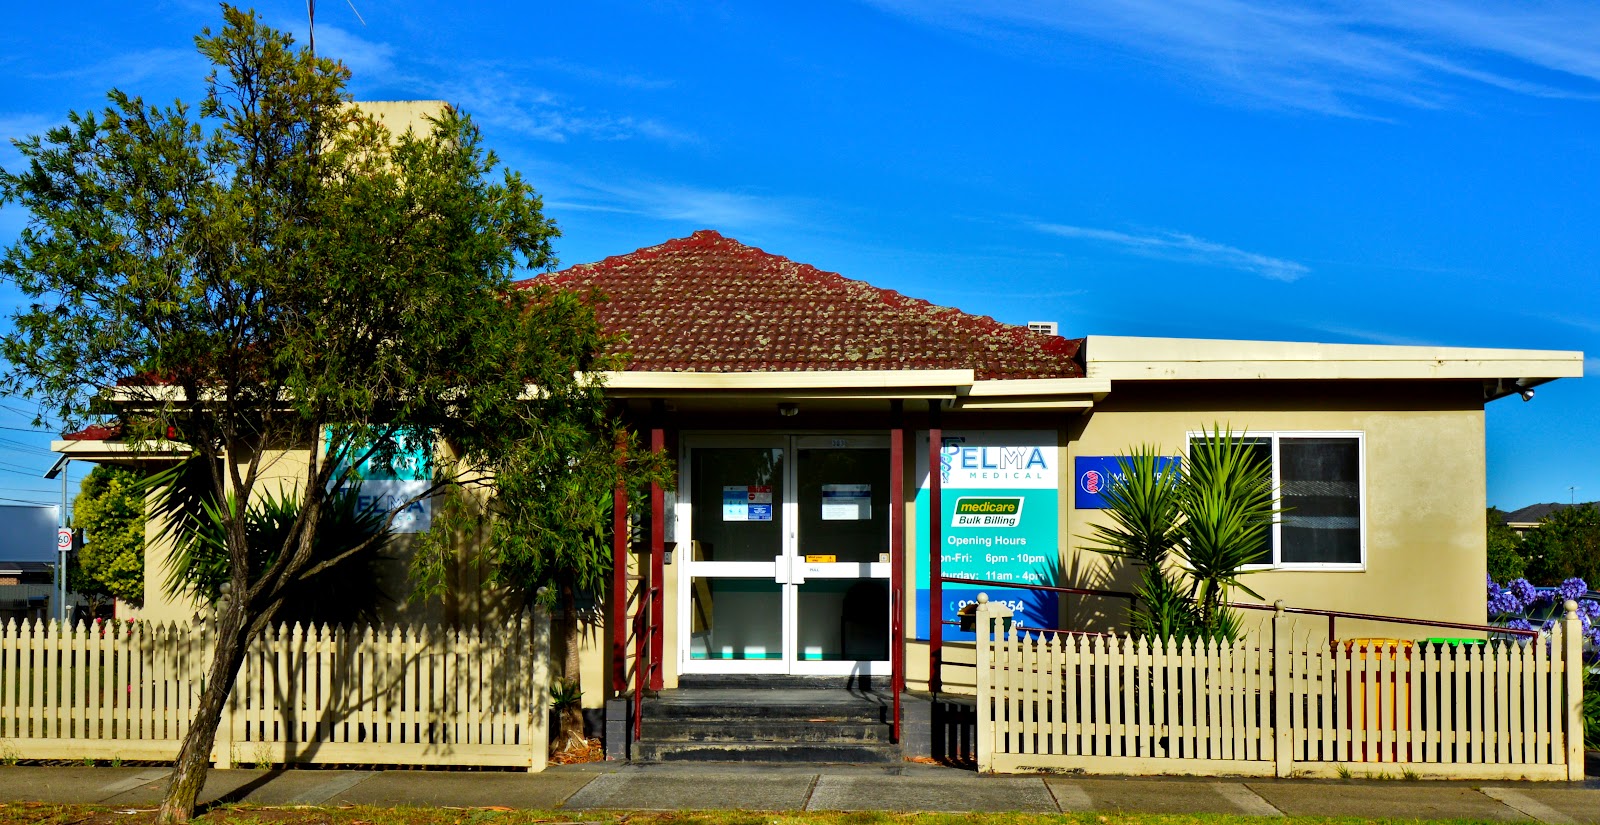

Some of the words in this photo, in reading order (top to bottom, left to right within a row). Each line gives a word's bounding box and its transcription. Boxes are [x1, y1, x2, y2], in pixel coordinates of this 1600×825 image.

[960, 501, 1016, 513] medicare
[958, 516, 981, 525] Bulk
[984, 516, 1016, 527] Billing
[58, 536, 68, 544] 60
[947, 536, 992, 547] Opening
[995, 536, 1027, 545] Hours
[938, 553, 973, 563] on-Fri:
[985, 554, 1008, 564] 6pm
[1017, 554, 1045, 564] 10pm
[940, 571, 979, 581] turday:
[985, 571, 1013, 580] 11am
[1022, 571, 1045, 582] 4pm
